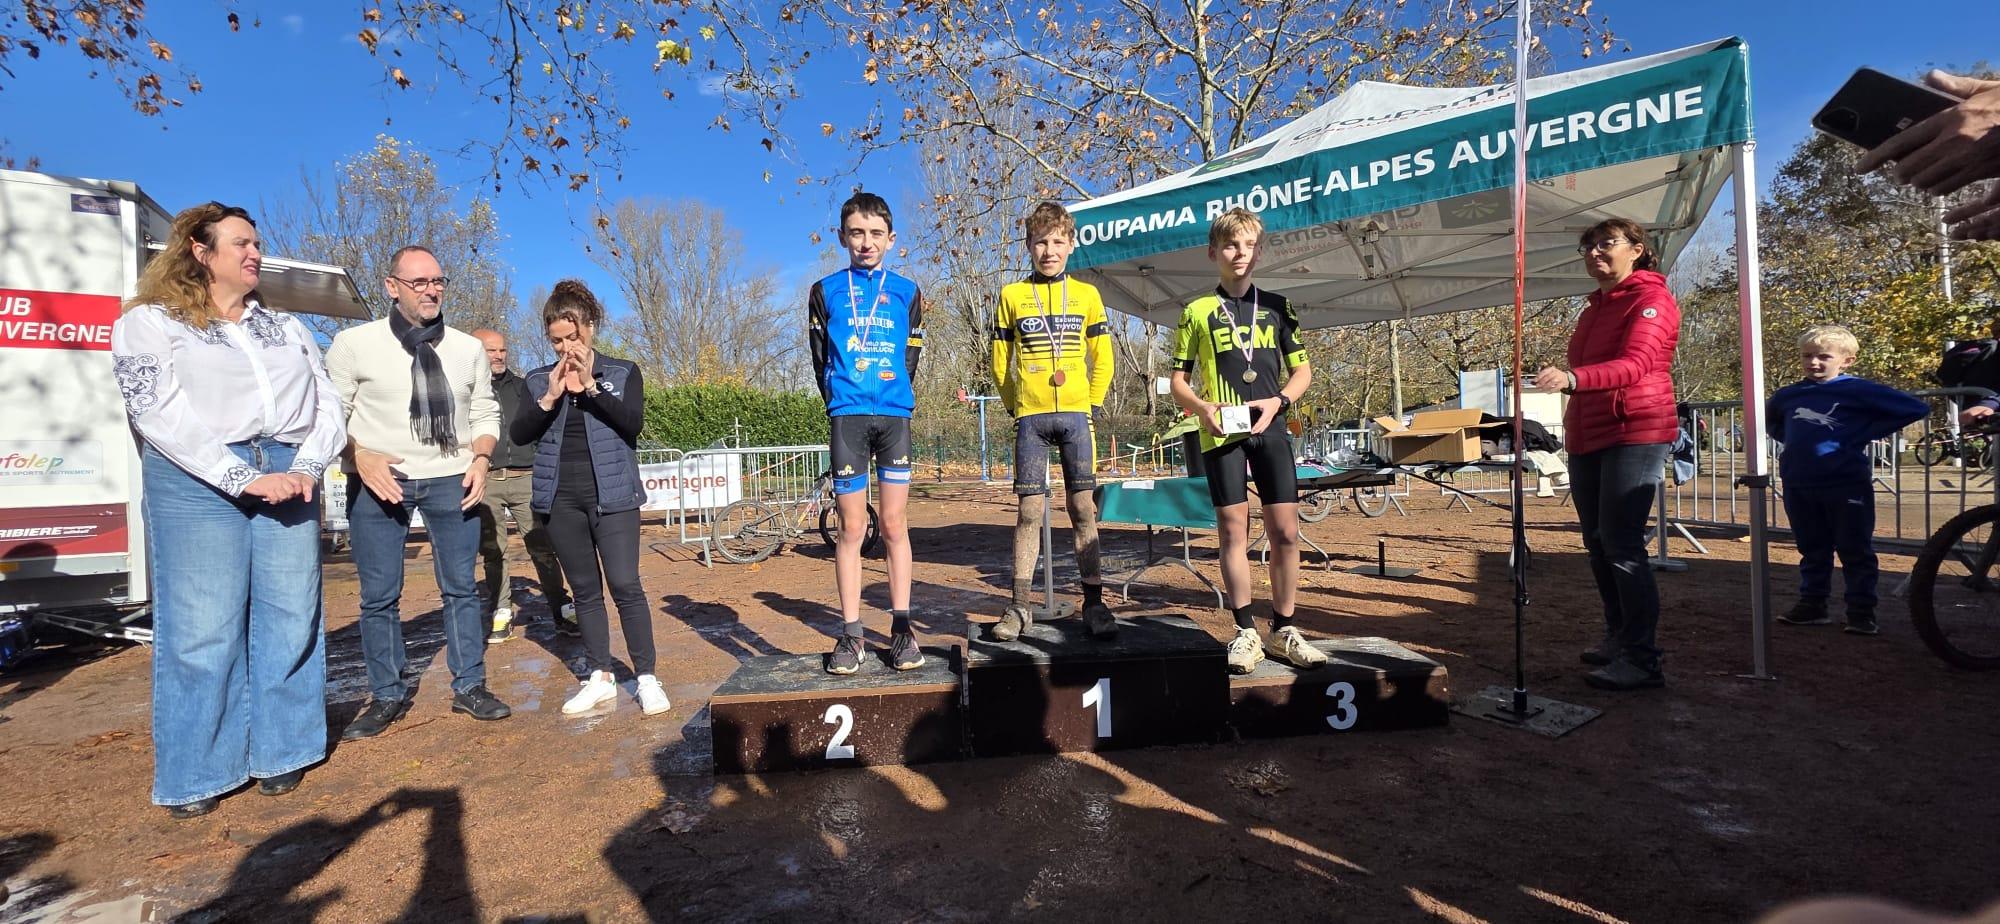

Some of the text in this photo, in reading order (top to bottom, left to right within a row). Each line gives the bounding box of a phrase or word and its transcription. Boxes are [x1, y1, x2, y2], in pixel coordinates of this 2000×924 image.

[1206, 148, 1435, 222] RHÔNE-ALPES
[1448, 86, 1704, 169] AUVERGNE
[0, 320, 112, 343] VERGNE
[1212, 323, 1277, 353] ECM
[641, 475, 727, 492] ontagne
[1083, 677, 1112, 738] 1
[1326, 682, 1359, 729] 3
[825, 704, 855, 760] 2
